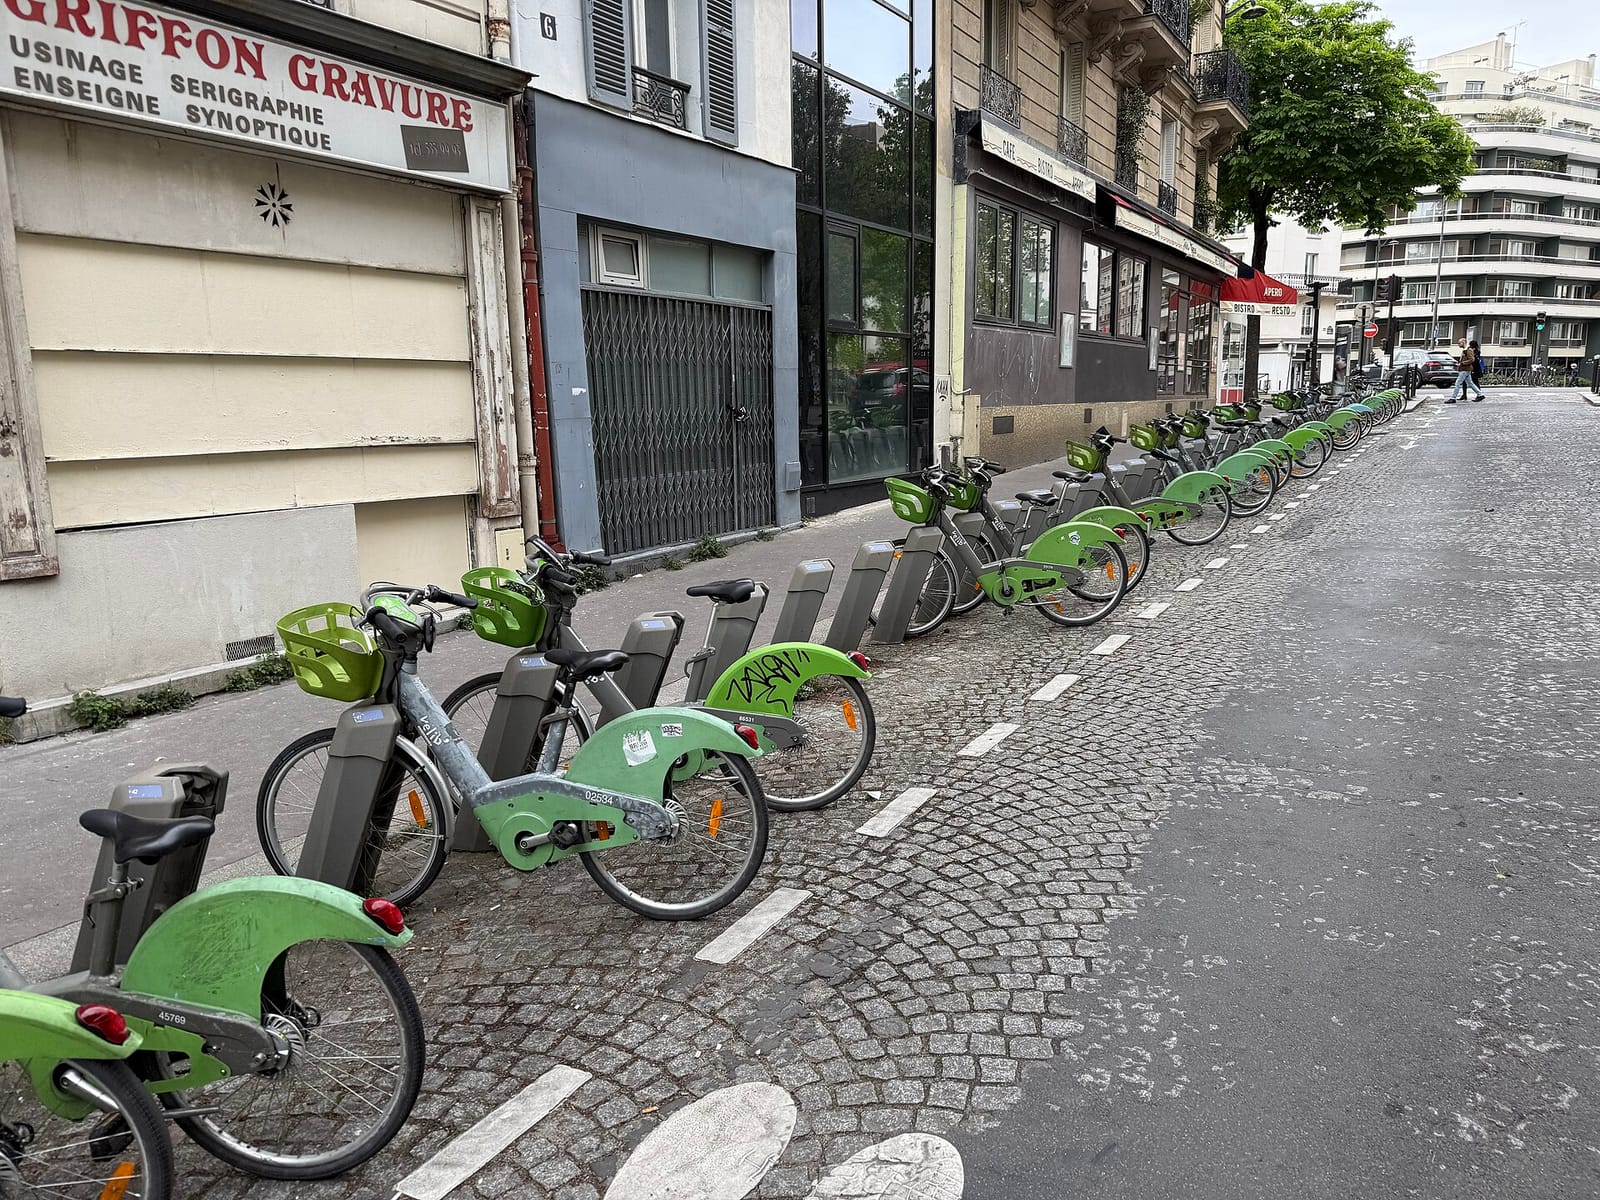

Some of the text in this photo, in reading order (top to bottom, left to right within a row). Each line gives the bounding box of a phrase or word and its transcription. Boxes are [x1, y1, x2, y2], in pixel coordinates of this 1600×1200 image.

[544, 16, 553, 38] 6
[9, 34, 324, 125] USINAGE SERIGRAPHIE
[288, 54, 473, 132] GRAVURE
[14, 66, 331, 150] ENSEIGNE SYNOPTIQUE
[1002, 140, 1016, 160] CAFE
[1263, 287, 1283, 297] APERO
[1233, 303, 1291, 315] BISTRO RESTO
